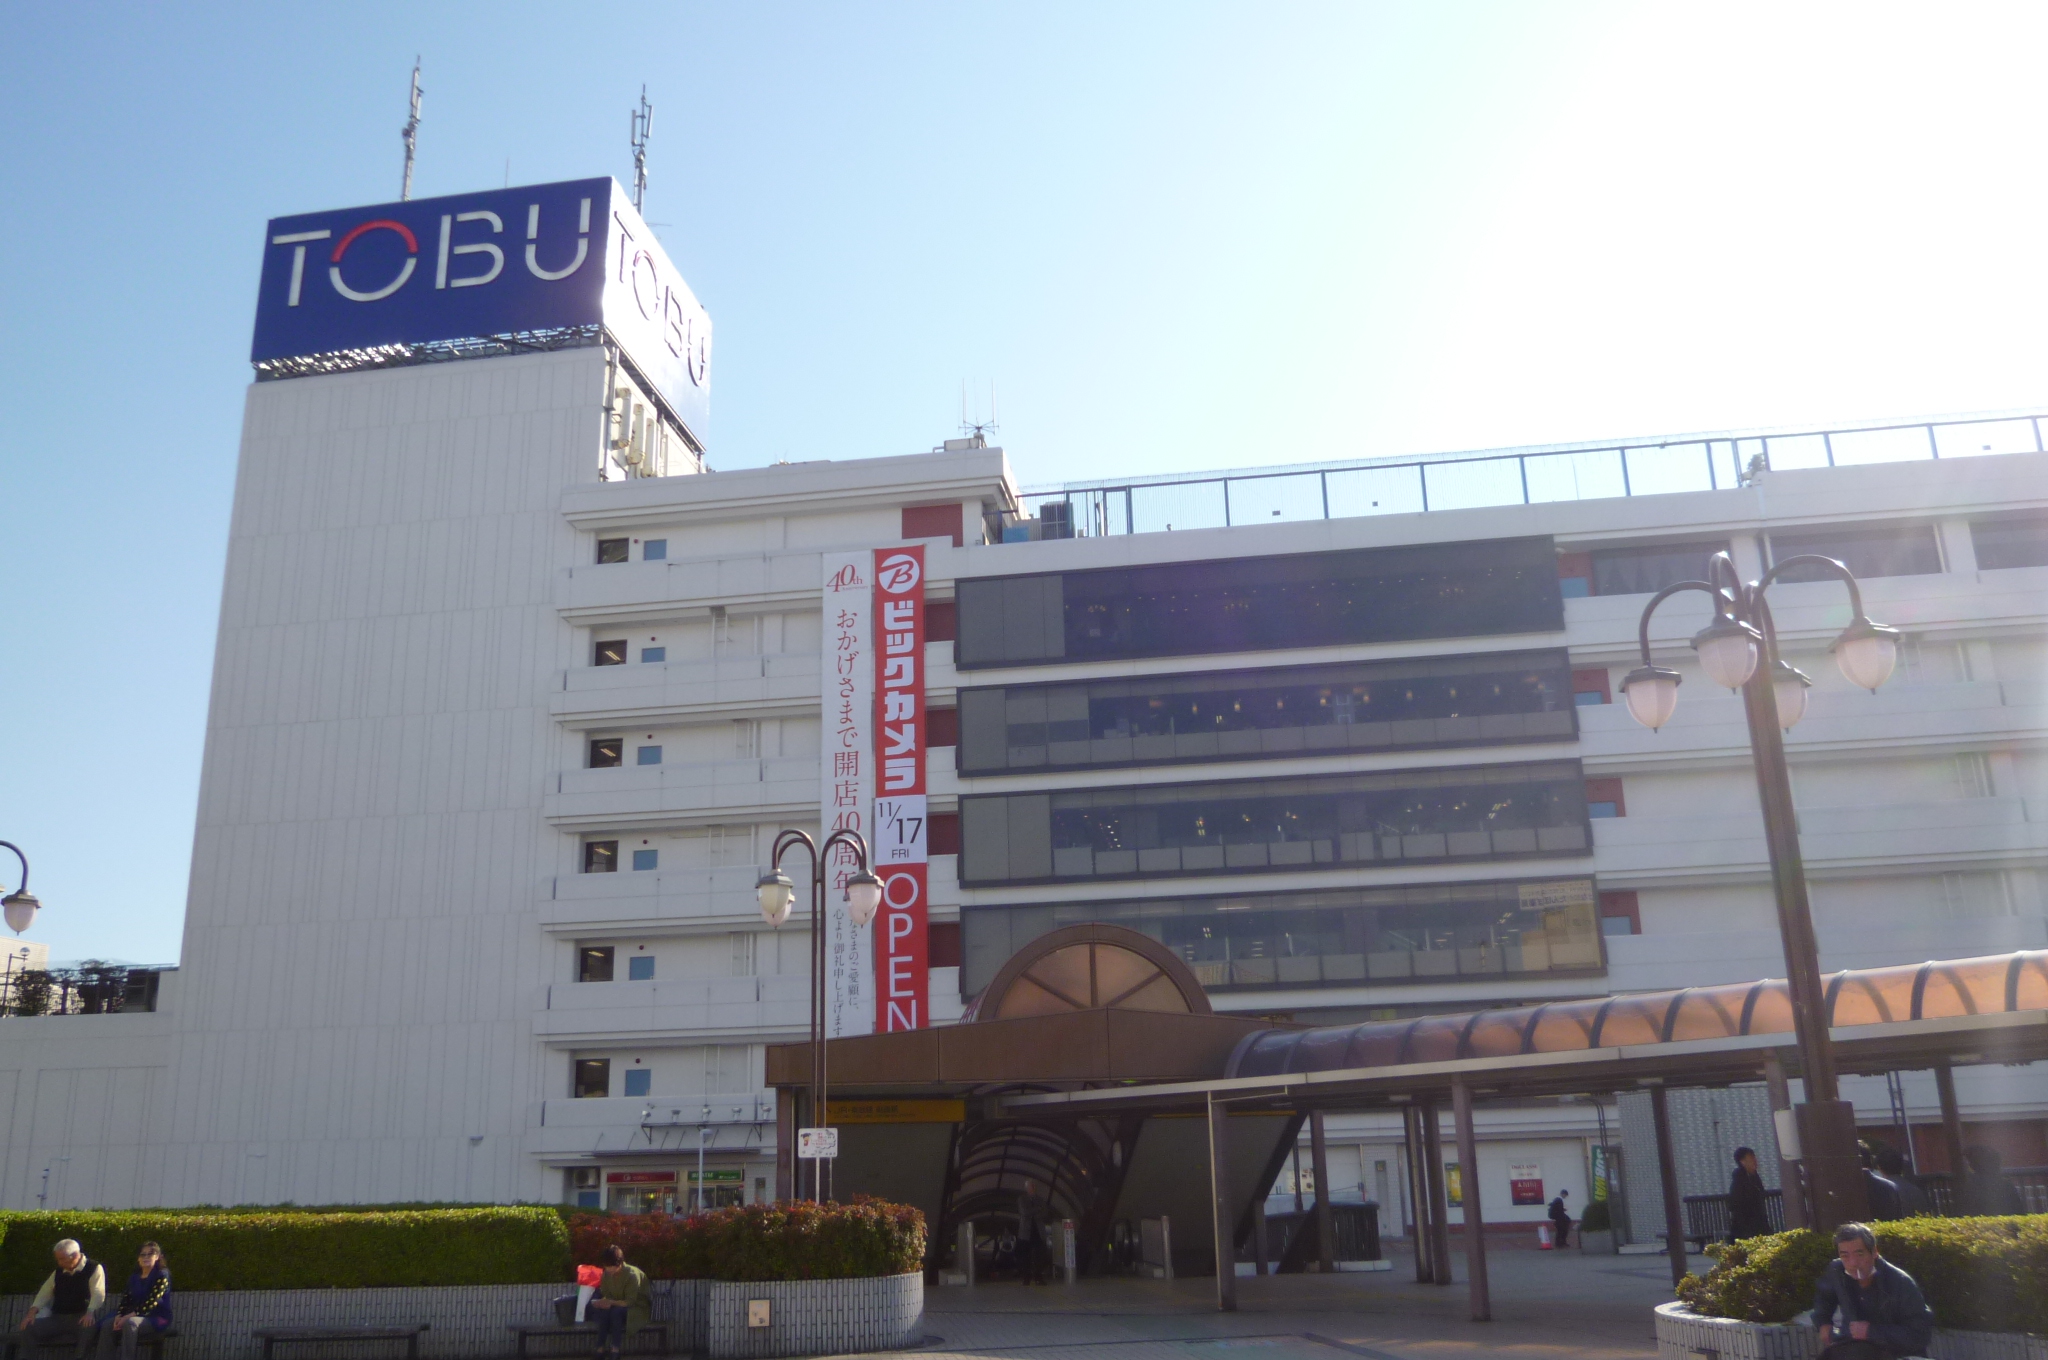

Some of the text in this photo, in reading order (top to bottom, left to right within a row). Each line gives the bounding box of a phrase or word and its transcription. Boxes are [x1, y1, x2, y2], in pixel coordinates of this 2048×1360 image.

[272, 197, 591, 307] TOBU
[614, 210, 706, 387] TOBU
[825, 563, 863, 593] 40th
[883, 599, 917, 791] ビックカメラ
[891, 849, 910, 859] FRI
[883, 872, 919, 1033] OPEN
[1594, 1148, 1607, 1201] SUBWAY
